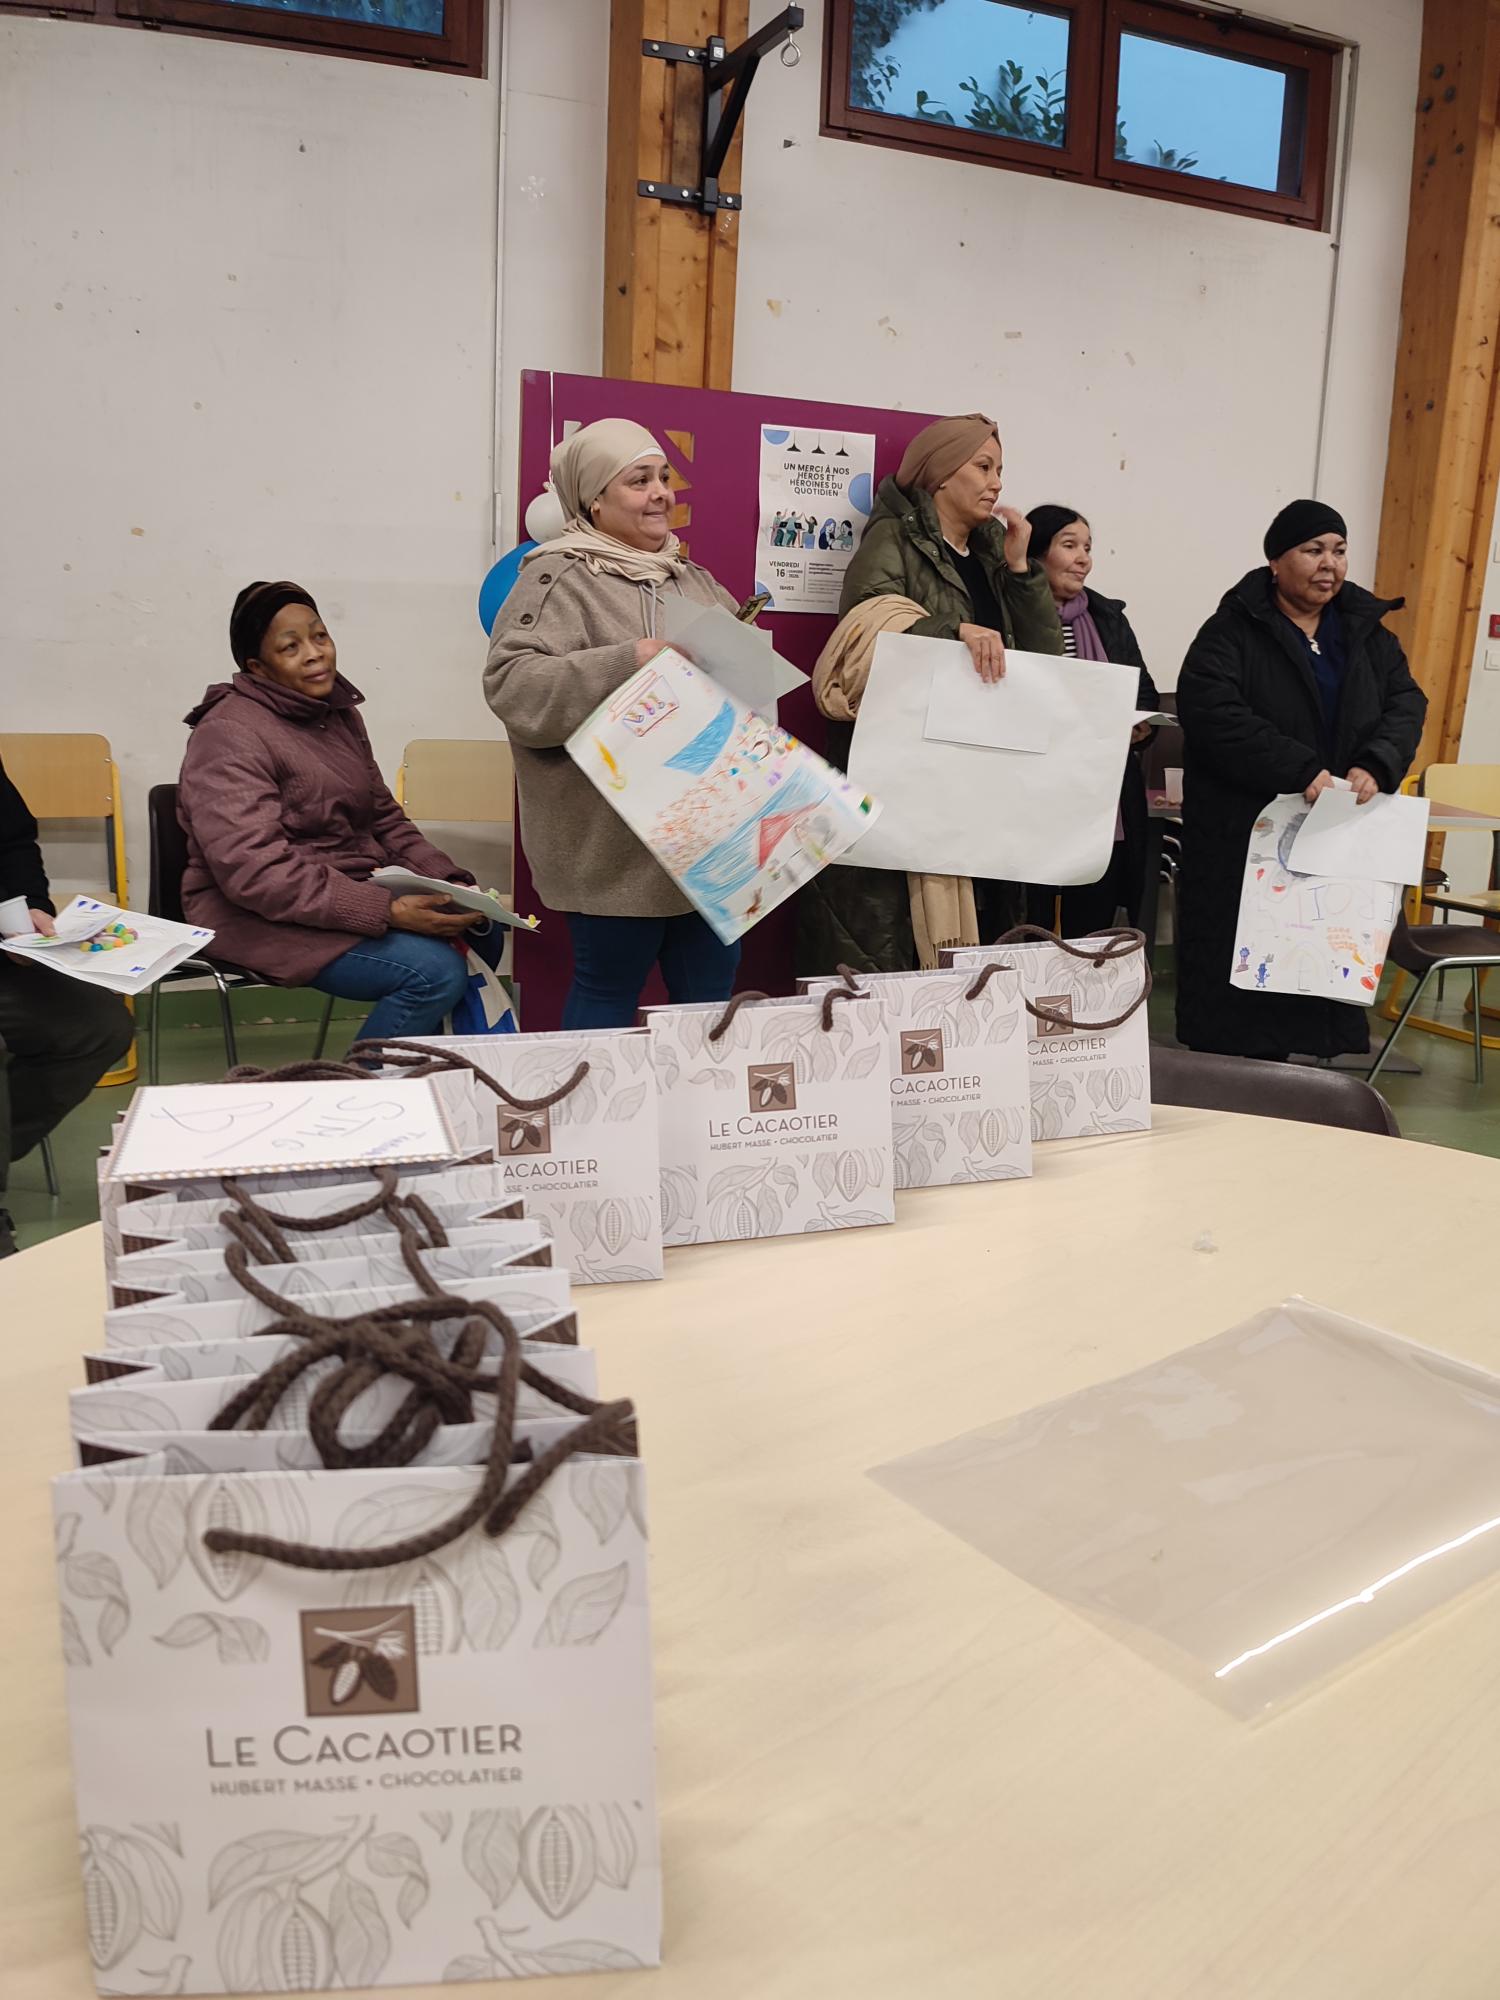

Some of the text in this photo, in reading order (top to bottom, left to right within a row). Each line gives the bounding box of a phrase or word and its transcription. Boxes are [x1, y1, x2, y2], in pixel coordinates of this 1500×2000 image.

[784, 462, 796, 470] UN
[798, 464, 823, 472] MERCI
[833, 467, 850, 475] NOS
[794, 487, 839, 496] QUOTIDIEN
[831, 482, 843, 490] DU
[769, 560, 800, 568] VENDREDI
[776, 568, 785, 577] 16
[1027, 1037, 1106, 1055] CACAOTIER
[1060, 1053, 1106, 1063] CHOCOLATIER
[889, 1075, 981, 1095] CACAOTIER
[928, 1093, 981, 1104] CHOCOLATIER
[709, 1113, 838, 1138] LE CACAOTIER
[710, 1133, 838, 1150] HUBERT MASSE CHOCOLATIER
[494, 1159, 598, 1178] ACAOTIER
[531, 1180, 598, 1191] CHOCOLATIER
[206, 1723, 523, 1768] LE CACAOTIER
[210, 1766, 523, 1797] HUBERT MASSE CHOCOLATIER
